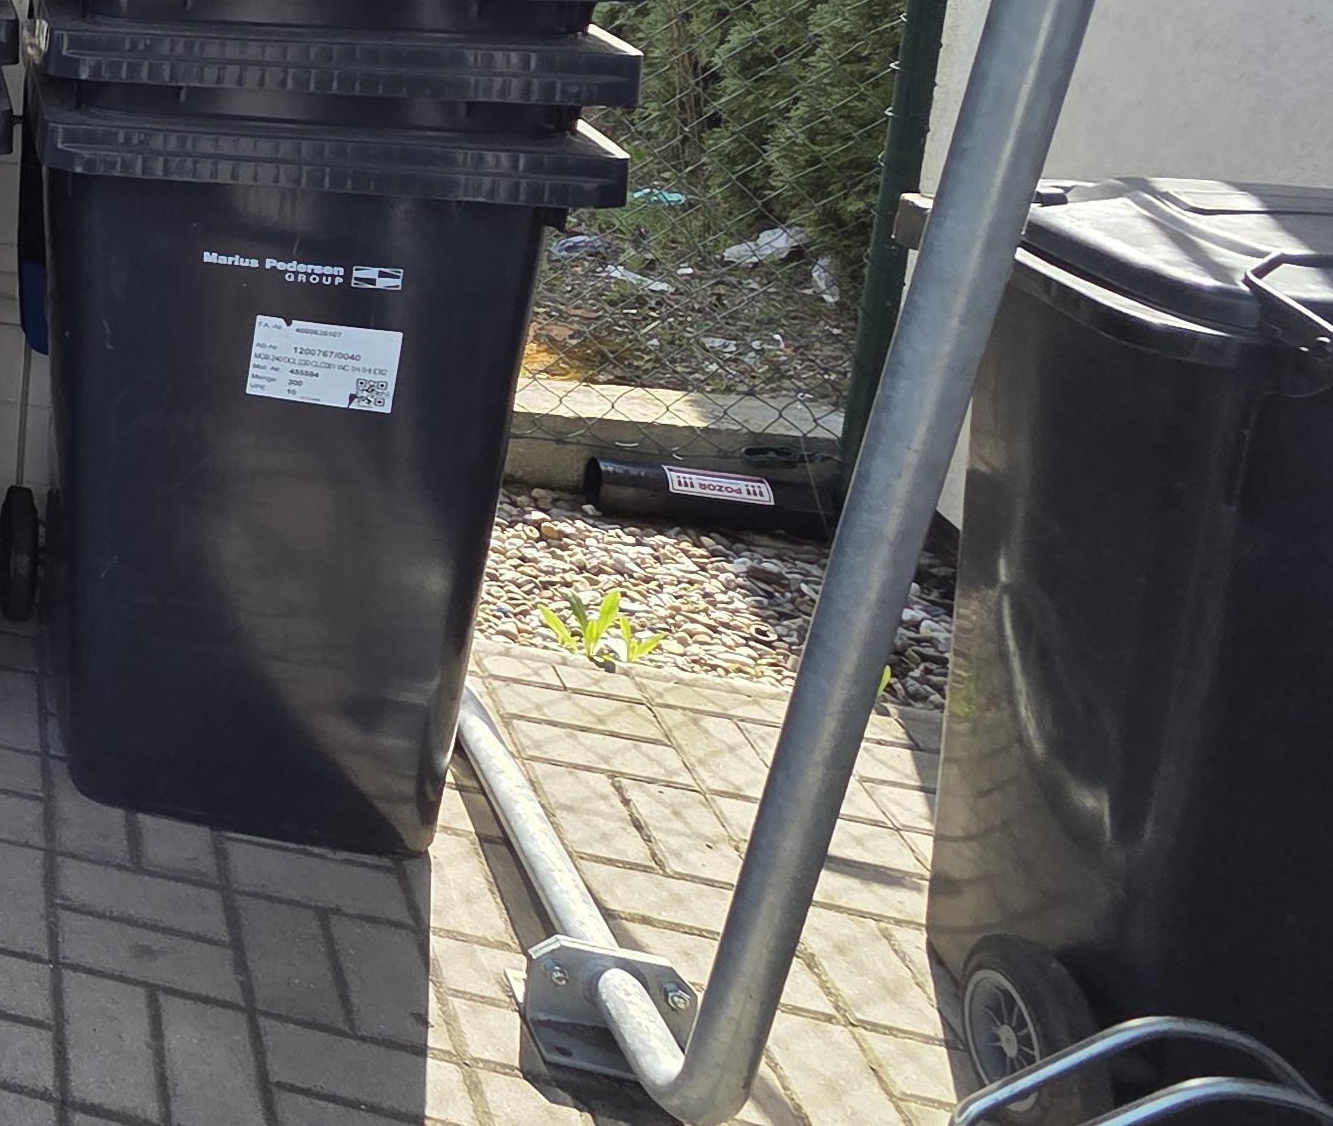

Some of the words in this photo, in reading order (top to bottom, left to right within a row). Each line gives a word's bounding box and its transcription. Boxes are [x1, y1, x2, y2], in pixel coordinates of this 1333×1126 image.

[203, 251, 260, 269] Marius
[265, 258, 345, 277] Pedersen
[285, 273, 345, 286] GROUP
[699, 483, 742, 494] POZOR
